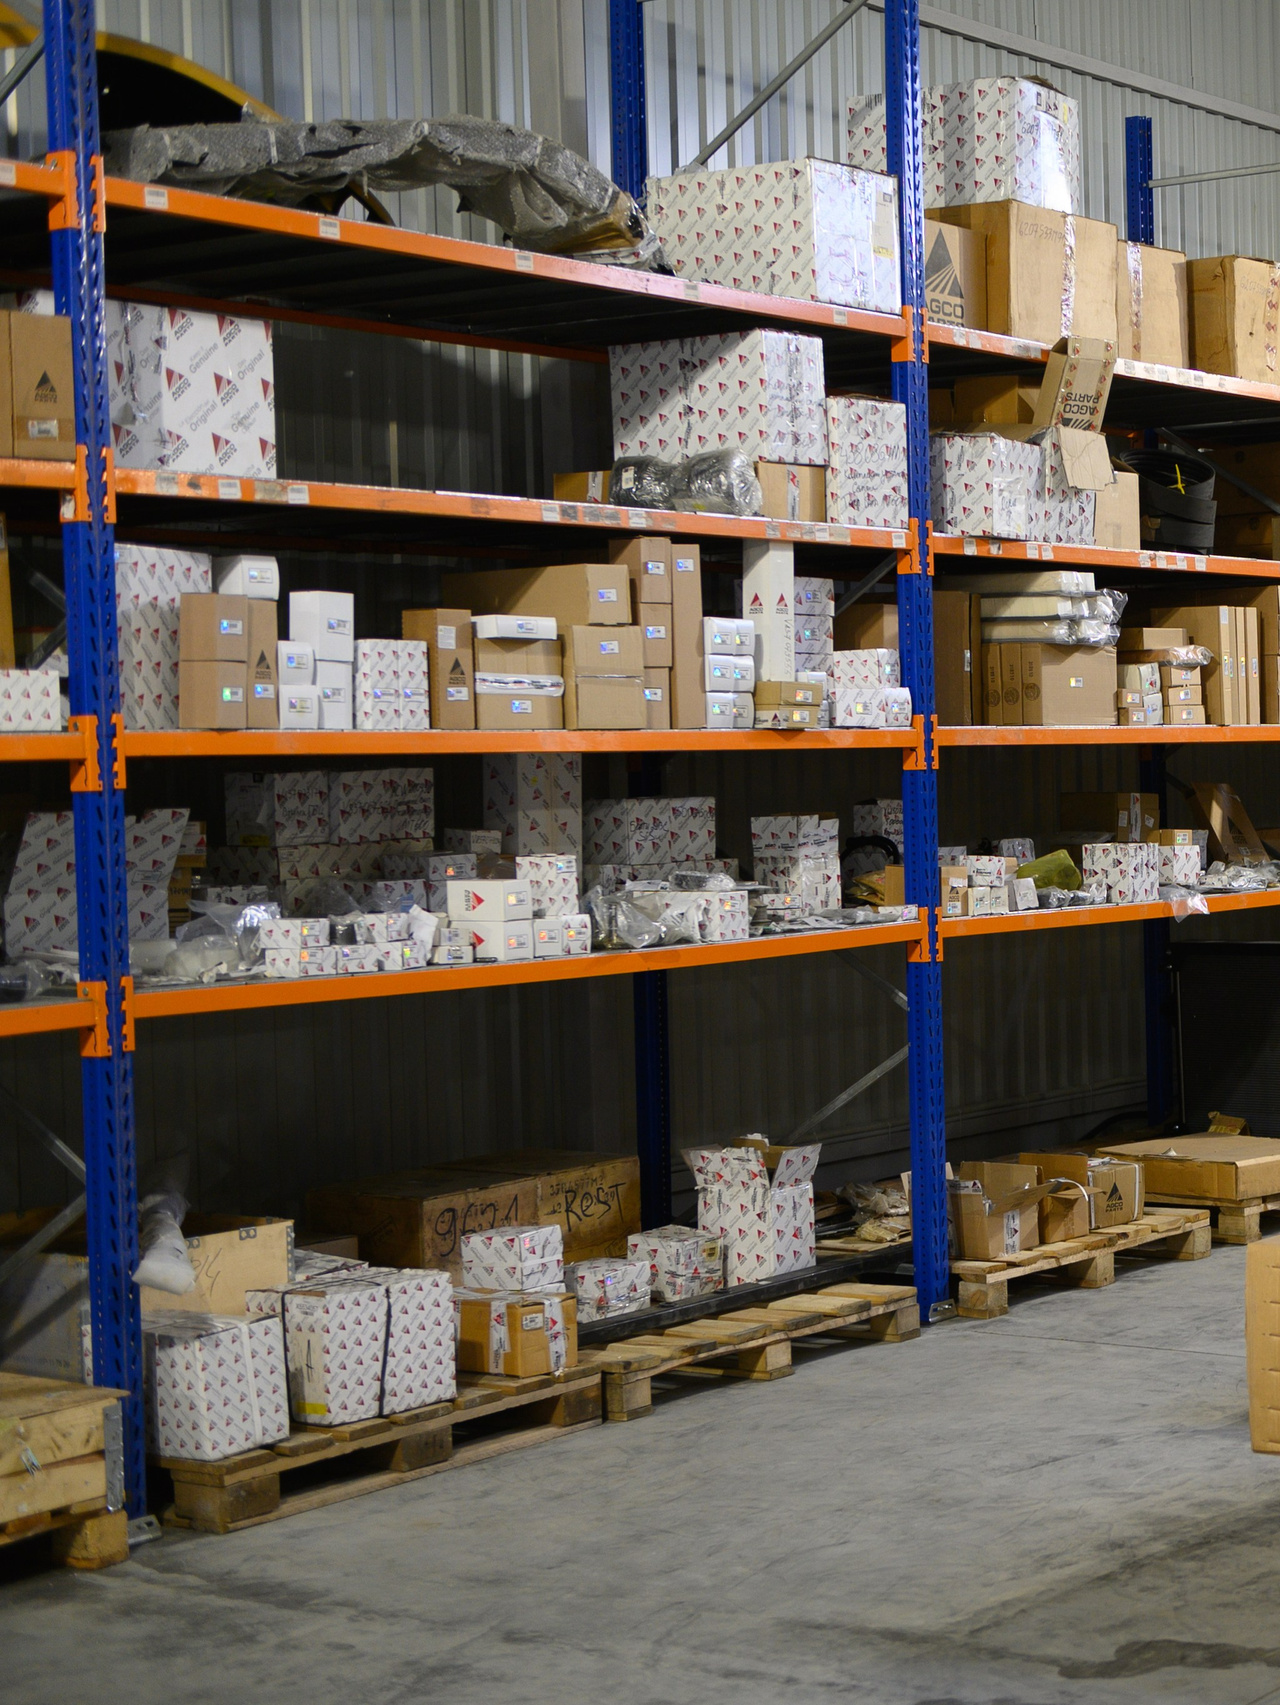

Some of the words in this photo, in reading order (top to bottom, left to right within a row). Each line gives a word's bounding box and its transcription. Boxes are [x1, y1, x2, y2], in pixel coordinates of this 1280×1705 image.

[173, 317, 192, 337] AGCO
[176, 320, 195, 342] PARTS
[222, 323, 240, 343] AGCO
[224, 328, 242, 347] PARTS
[188, 342, 219, 375] Genuine
[237, 349, 265, 381] Original
[171, 378, 189, 398] AGCO
[173, 381, 192, 402] PARTS
[220, 383, 237, 403] AGCO
[222, 387, 239, 407] PARTS
[1066, 392, 1100, 404] PARTS
[189, 400, 218, 432] Original
[231, 401, 260, 433] Genuine
[1063, 403, 1096, 415] AGCO
[119, 434, 137, 454] AGCO
[121, 438, 140, 459] PARTS
[172, 443, 189, 463] PARTS
[218, 443, 235, 463] AGCO
[220, 447, 238, 467] PARTS
